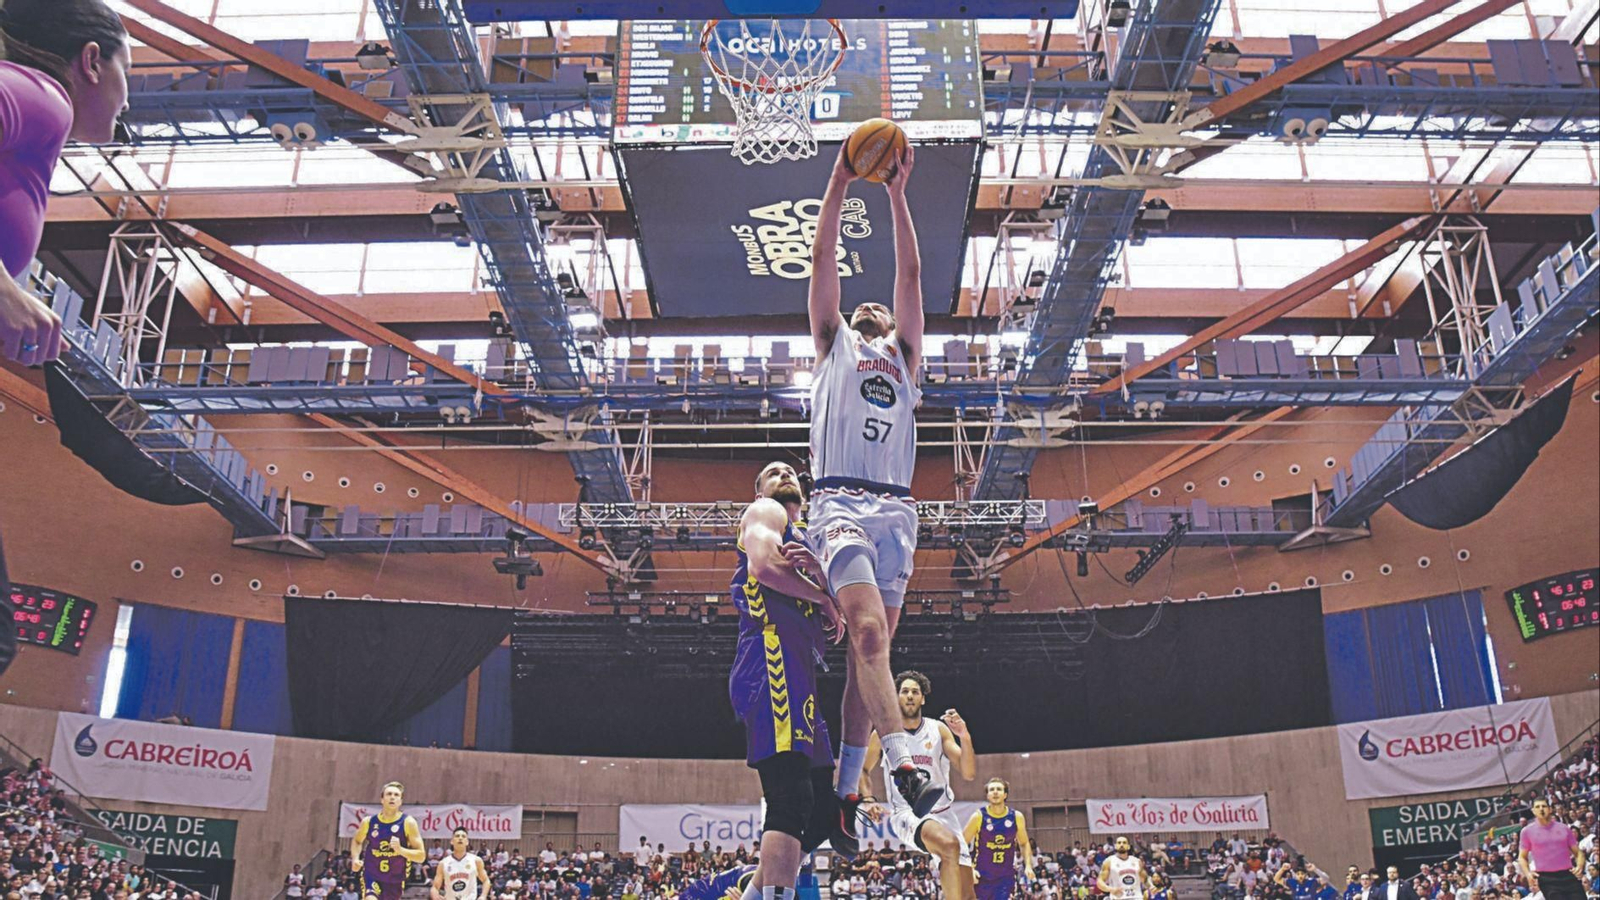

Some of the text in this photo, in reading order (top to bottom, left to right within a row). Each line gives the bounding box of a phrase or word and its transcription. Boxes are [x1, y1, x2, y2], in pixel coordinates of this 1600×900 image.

[788, 38, 867, 51] HOTELS
[731, 224, 770, 275] MONBUS
[748, 200, 813, 280] OBRA
[862, 417, 893, 443] 57
[1386, 718, 1537, 758] CABREIROÁ
[104, 738, 253, 772] CABREIROÁ
[98, 811, 206, 835] SAIDA DE
[422, 810, 441, 832] de
[446, 809, 512, 832] Galicia
[1095, 801, 1259, 828] La Voz de Galicia
[1399, 801, 1469, 823] SAIDA
[380, 859, 390, 873] 6
[993, 851, 1005, 863] 13
